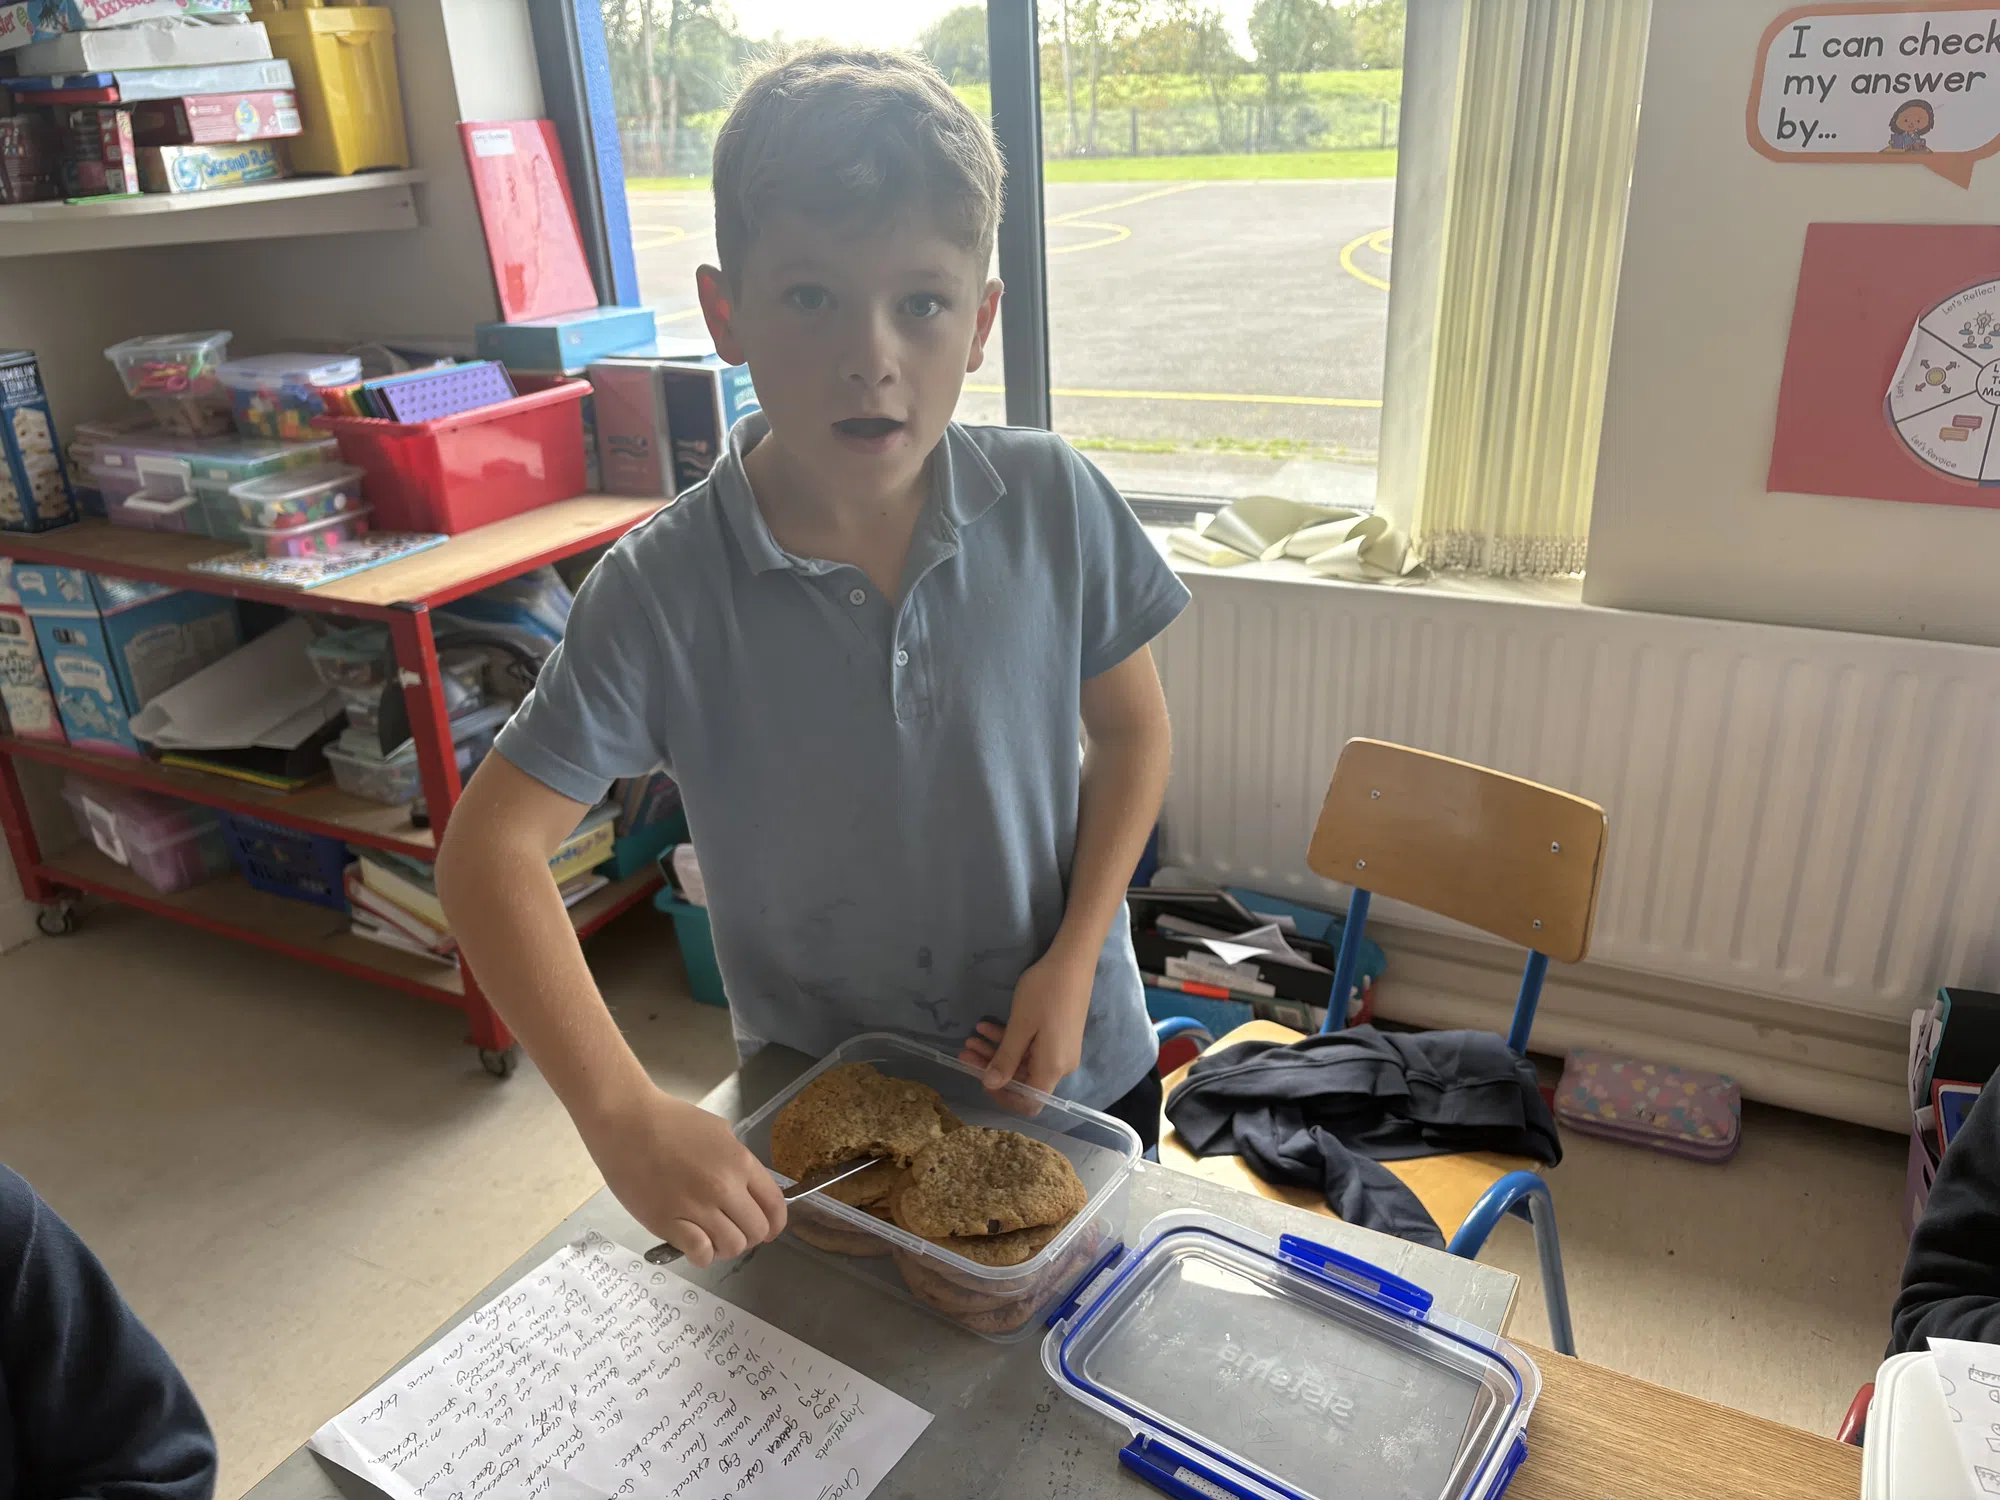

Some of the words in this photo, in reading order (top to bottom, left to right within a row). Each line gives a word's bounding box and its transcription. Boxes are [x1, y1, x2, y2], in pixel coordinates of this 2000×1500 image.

[1788, 25, 1811, 58] I
[1822, 36, 1883, 58] can
[1899, 19, 2000, 56] check
[1783, 74, 1837, 103] my
[1851, 71, 1986, 94] answer
[1777, 107, 1837, 148] by...
[1941, 299, 1962, 315] Let's
[1963, 285, 1996, 303] Reflect
[1911, 434, 1925, 452] Let's
[1926, 448, 1957, 469] Revoice
[537, 1274, 551, 1286] to
[564, 1287, 579, 1302] to
[580, 1302, 592, 1316] 10
[646, 1302, 669, 1329] until
[649, 1306, 681, 1337] Cream
[466, 1332, 475, 1342] a
[619, 1330, 643, 1351] very
[688, 1323, 713, 1349] Heat
[703, 1319, 734, 1360] Method
[625, 1344, 642, 1362] the
[713, 1341, 741, 1366] 150g
[406, 1364, 434, 1390] mins
[726, 1363, 748, 1379] tsp
[745, 1360, 775, 1386] 180g
[778, 1370, 788, 1380] 1
[485, 1381, 498, 1402] of
[513, 1376, 526, 1395] of
[517, 1385, 533, 1402] in
[634, 1386, 649, 1401] to
[678, 1381, 703, 1409] dark
[758, 1385, 777, 1401] tsp
[793, 1382, 801, 1391] 1
[797, 1387, 827, 1407] 75g
[357, 1392, 398, 1424] before
[454, 1400, 476, 1423] the
[492, 1405, 513, 1426] the
[588, 1395, 617, 1421] with
[659, 1389, 726, 1452] Bicarbonate
[746, 1403, 782, 1446] Medium
[814, 1392, 865, 1460] Ingredients
[497, 1433, 524, 1457] then
[519, 1422, 583, 1487] parchment.
[562, 1441, 585, 1470] and
[780, 1429, 813, 1466] Butter
[638, 1459, 652, 1477] of
[717, 1451, 741, 1474] Egg
[735, 1457, 764, 1492] Caster
[527, 1475, 550, 1500] line
[664, 1456, 710, 1498] extract.
